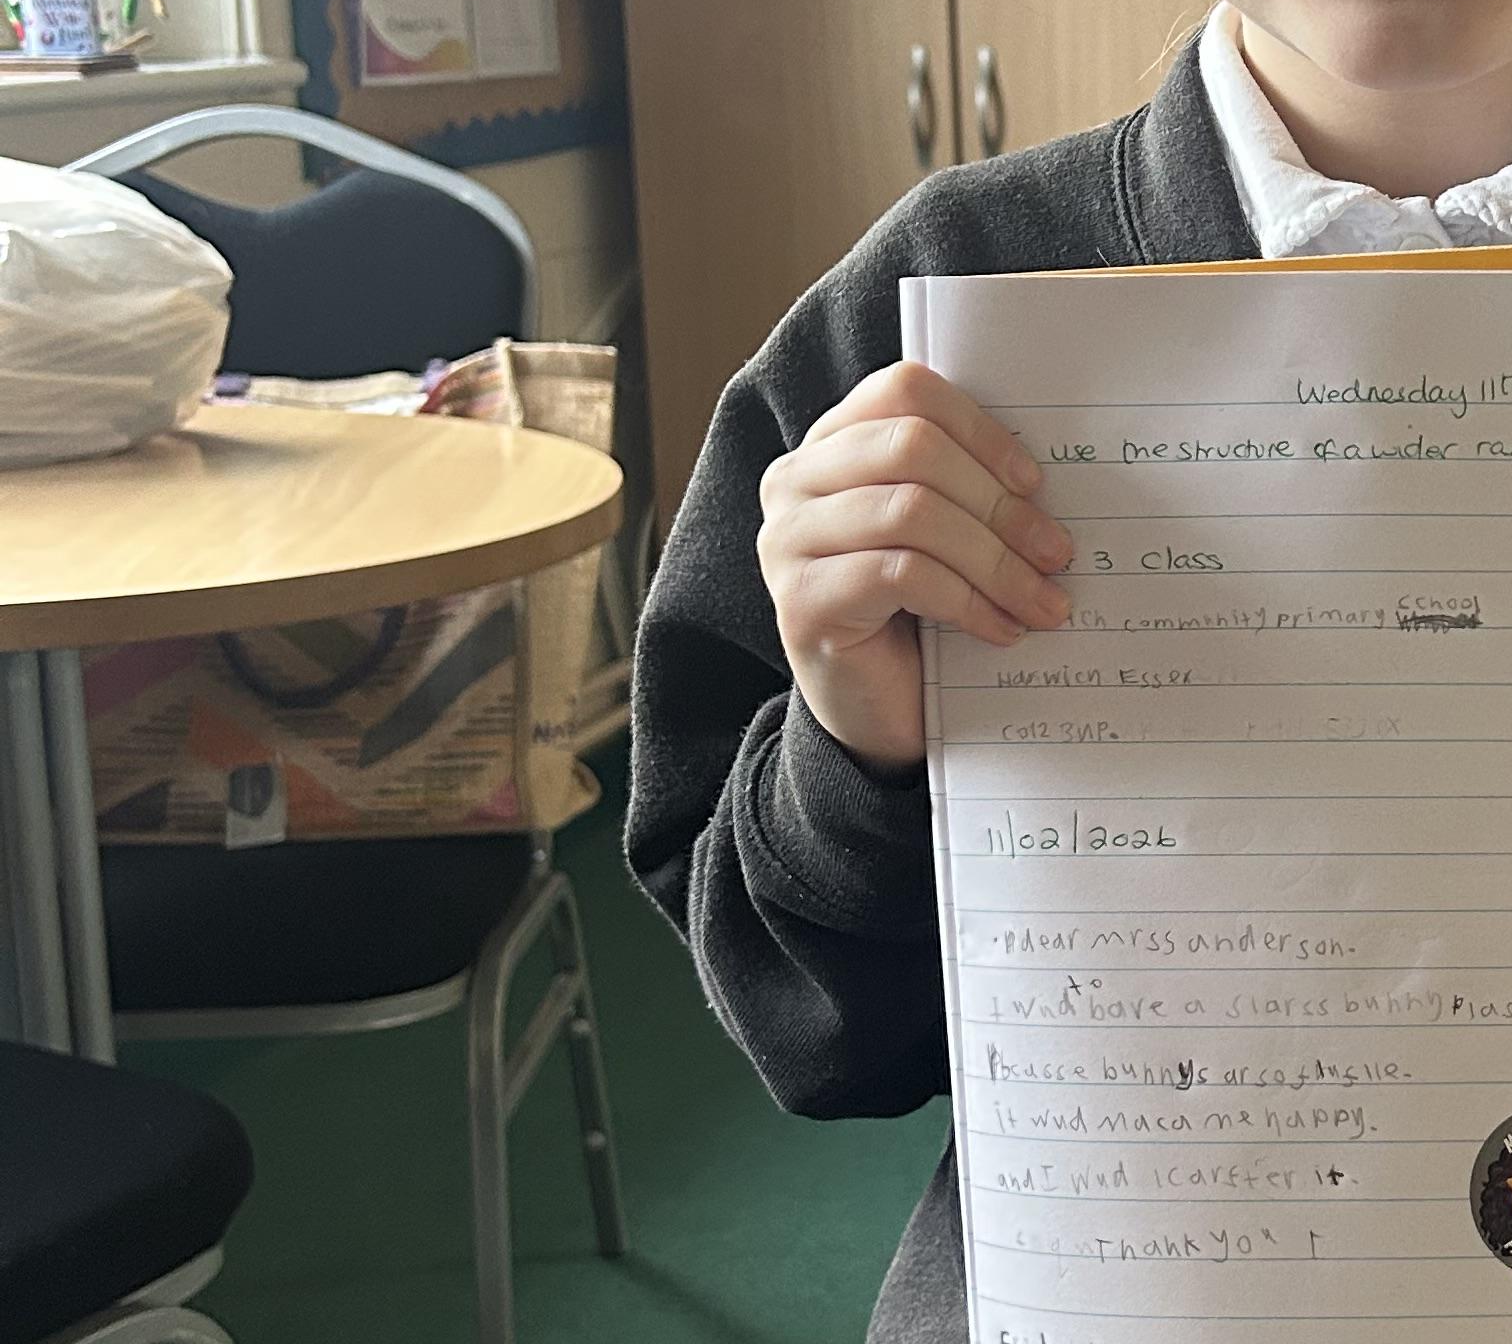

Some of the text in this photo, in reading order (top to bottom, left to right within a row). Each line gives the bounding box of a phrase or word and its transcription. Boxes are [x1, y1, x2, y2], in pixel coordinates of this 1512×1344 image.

[1297, 374, 1467, 419] Wednesday
[1050, 443, 1097, 462] use
[1179, 439, 1296, 461] structure
[1094, 550, 1113, 570] 3
[1277, 607, 1384, 629] primary
[988, 810, 1177, 858] 11/02/2026
